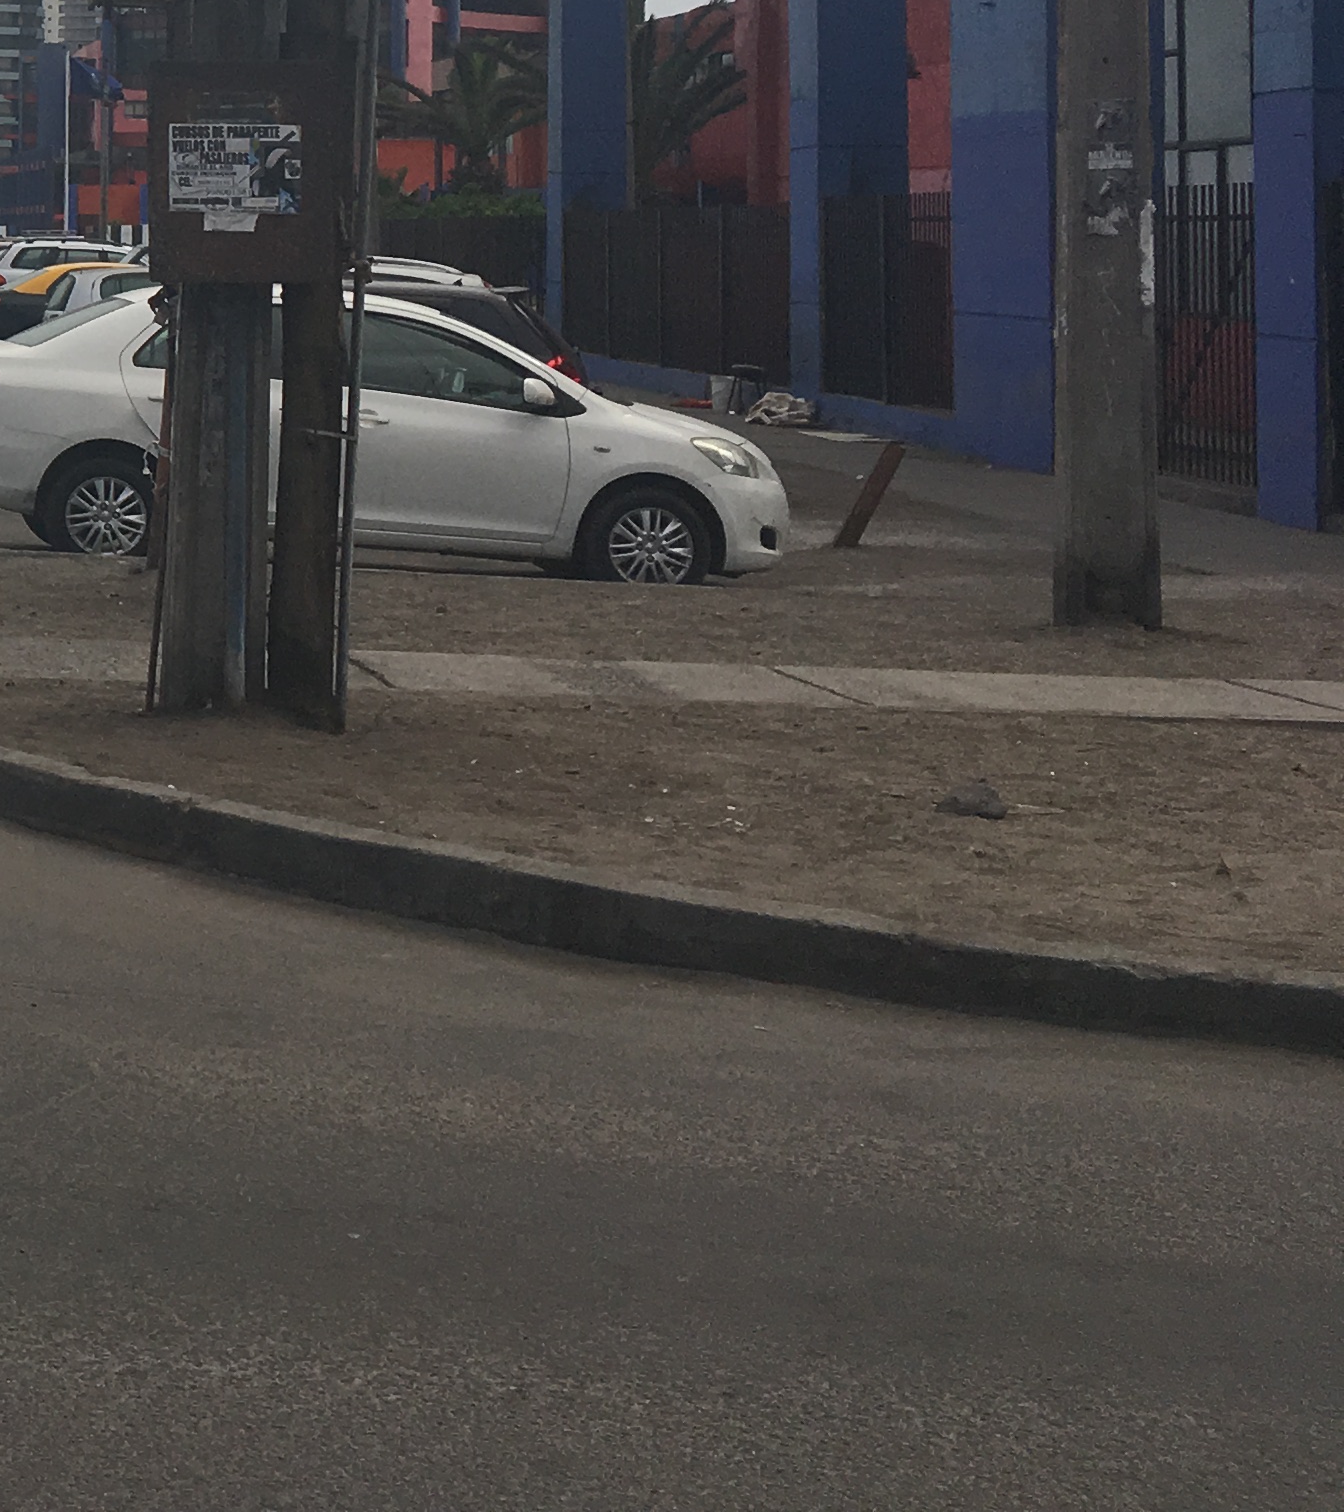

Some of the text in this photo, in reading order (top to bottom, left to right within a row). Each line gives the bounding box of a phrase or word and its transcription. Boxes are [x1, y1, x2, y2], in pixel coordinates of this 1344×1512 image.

[172, 125, 280, 139] CURSOS DE PARAPENTE
[172, 140, 226, 152] VUELOS CON
[200, 152, 249, 164] PASAJEROS
